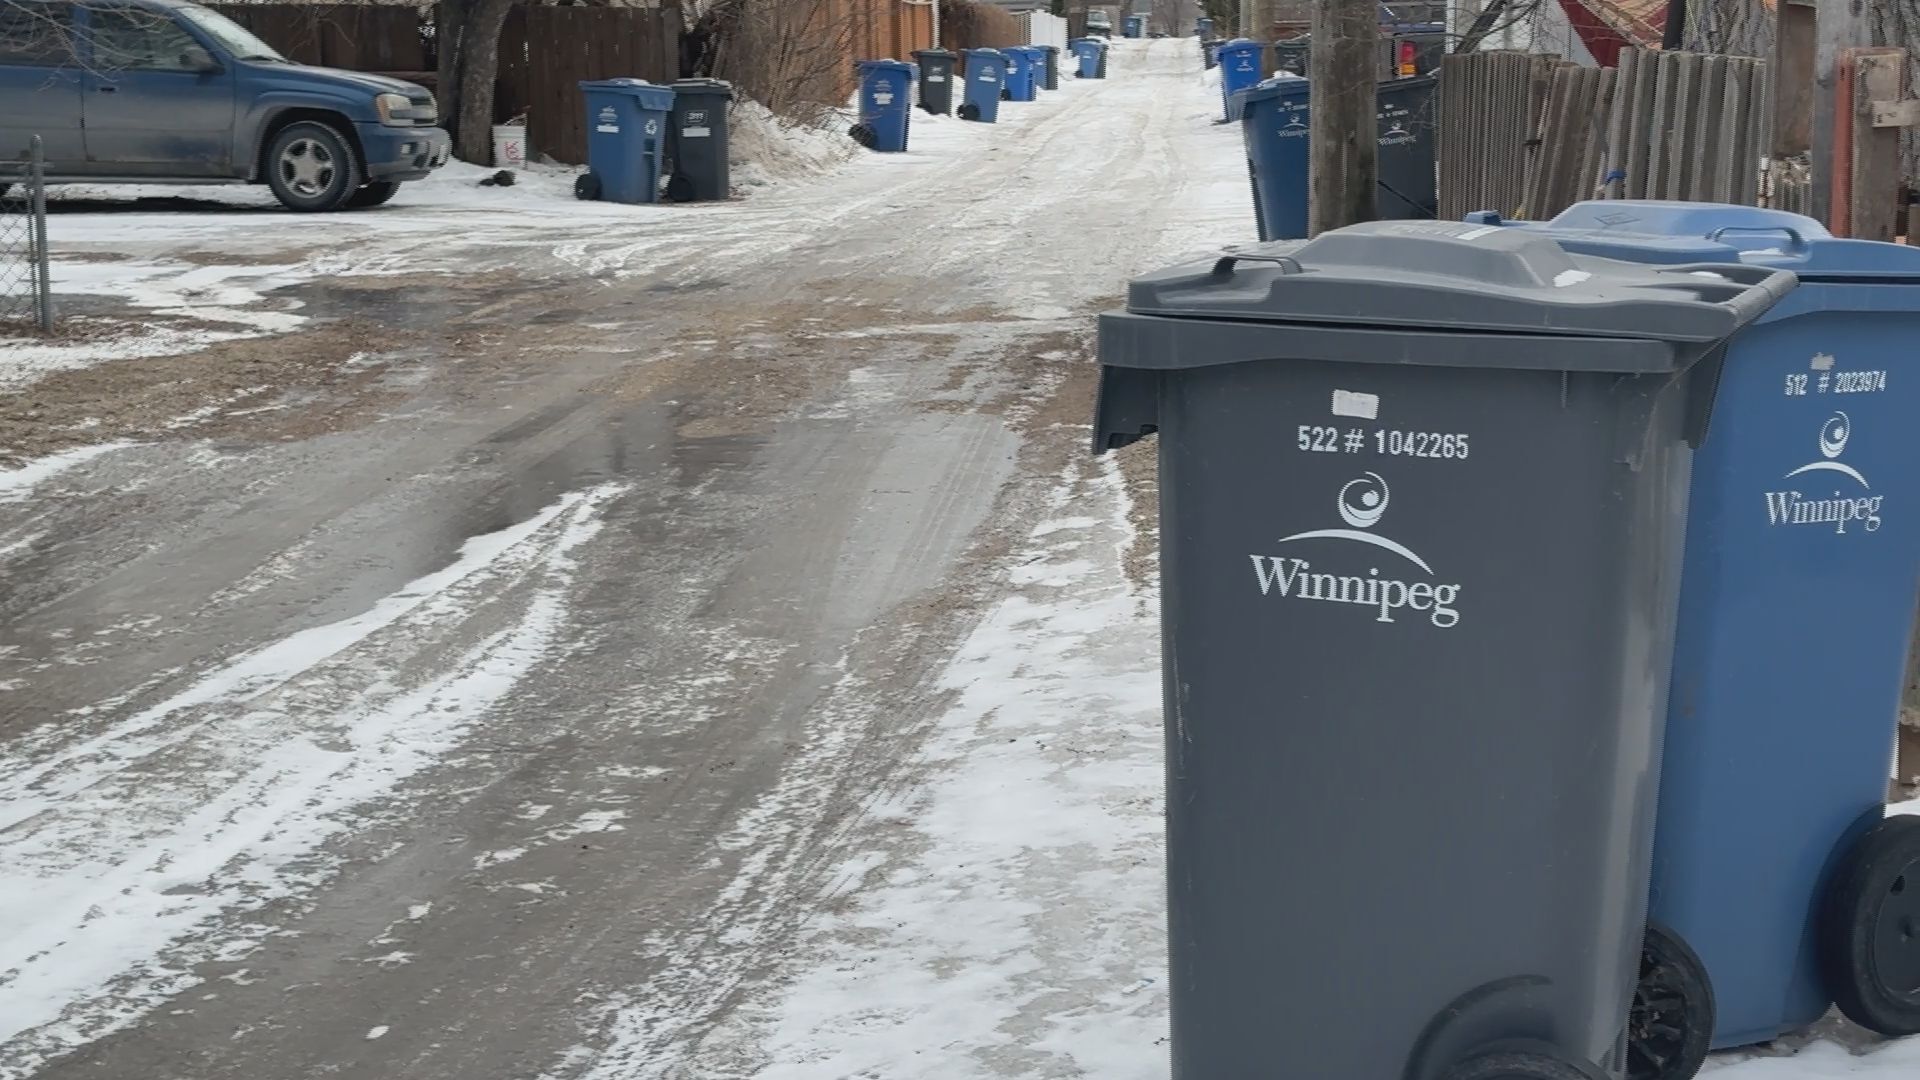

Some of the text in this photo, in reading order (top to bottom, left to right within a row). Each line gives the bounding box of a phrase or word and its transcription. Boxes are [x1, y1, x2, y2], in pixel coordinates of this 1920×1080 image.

[1784, 370, 1887, 396] 512 # 2023974
[1297, 425, 1469, 460] 522 # 1042265
[1764, 490, 1884, 534] Winnipeg
[1248, 554, 1461, 628] Winnipeg
